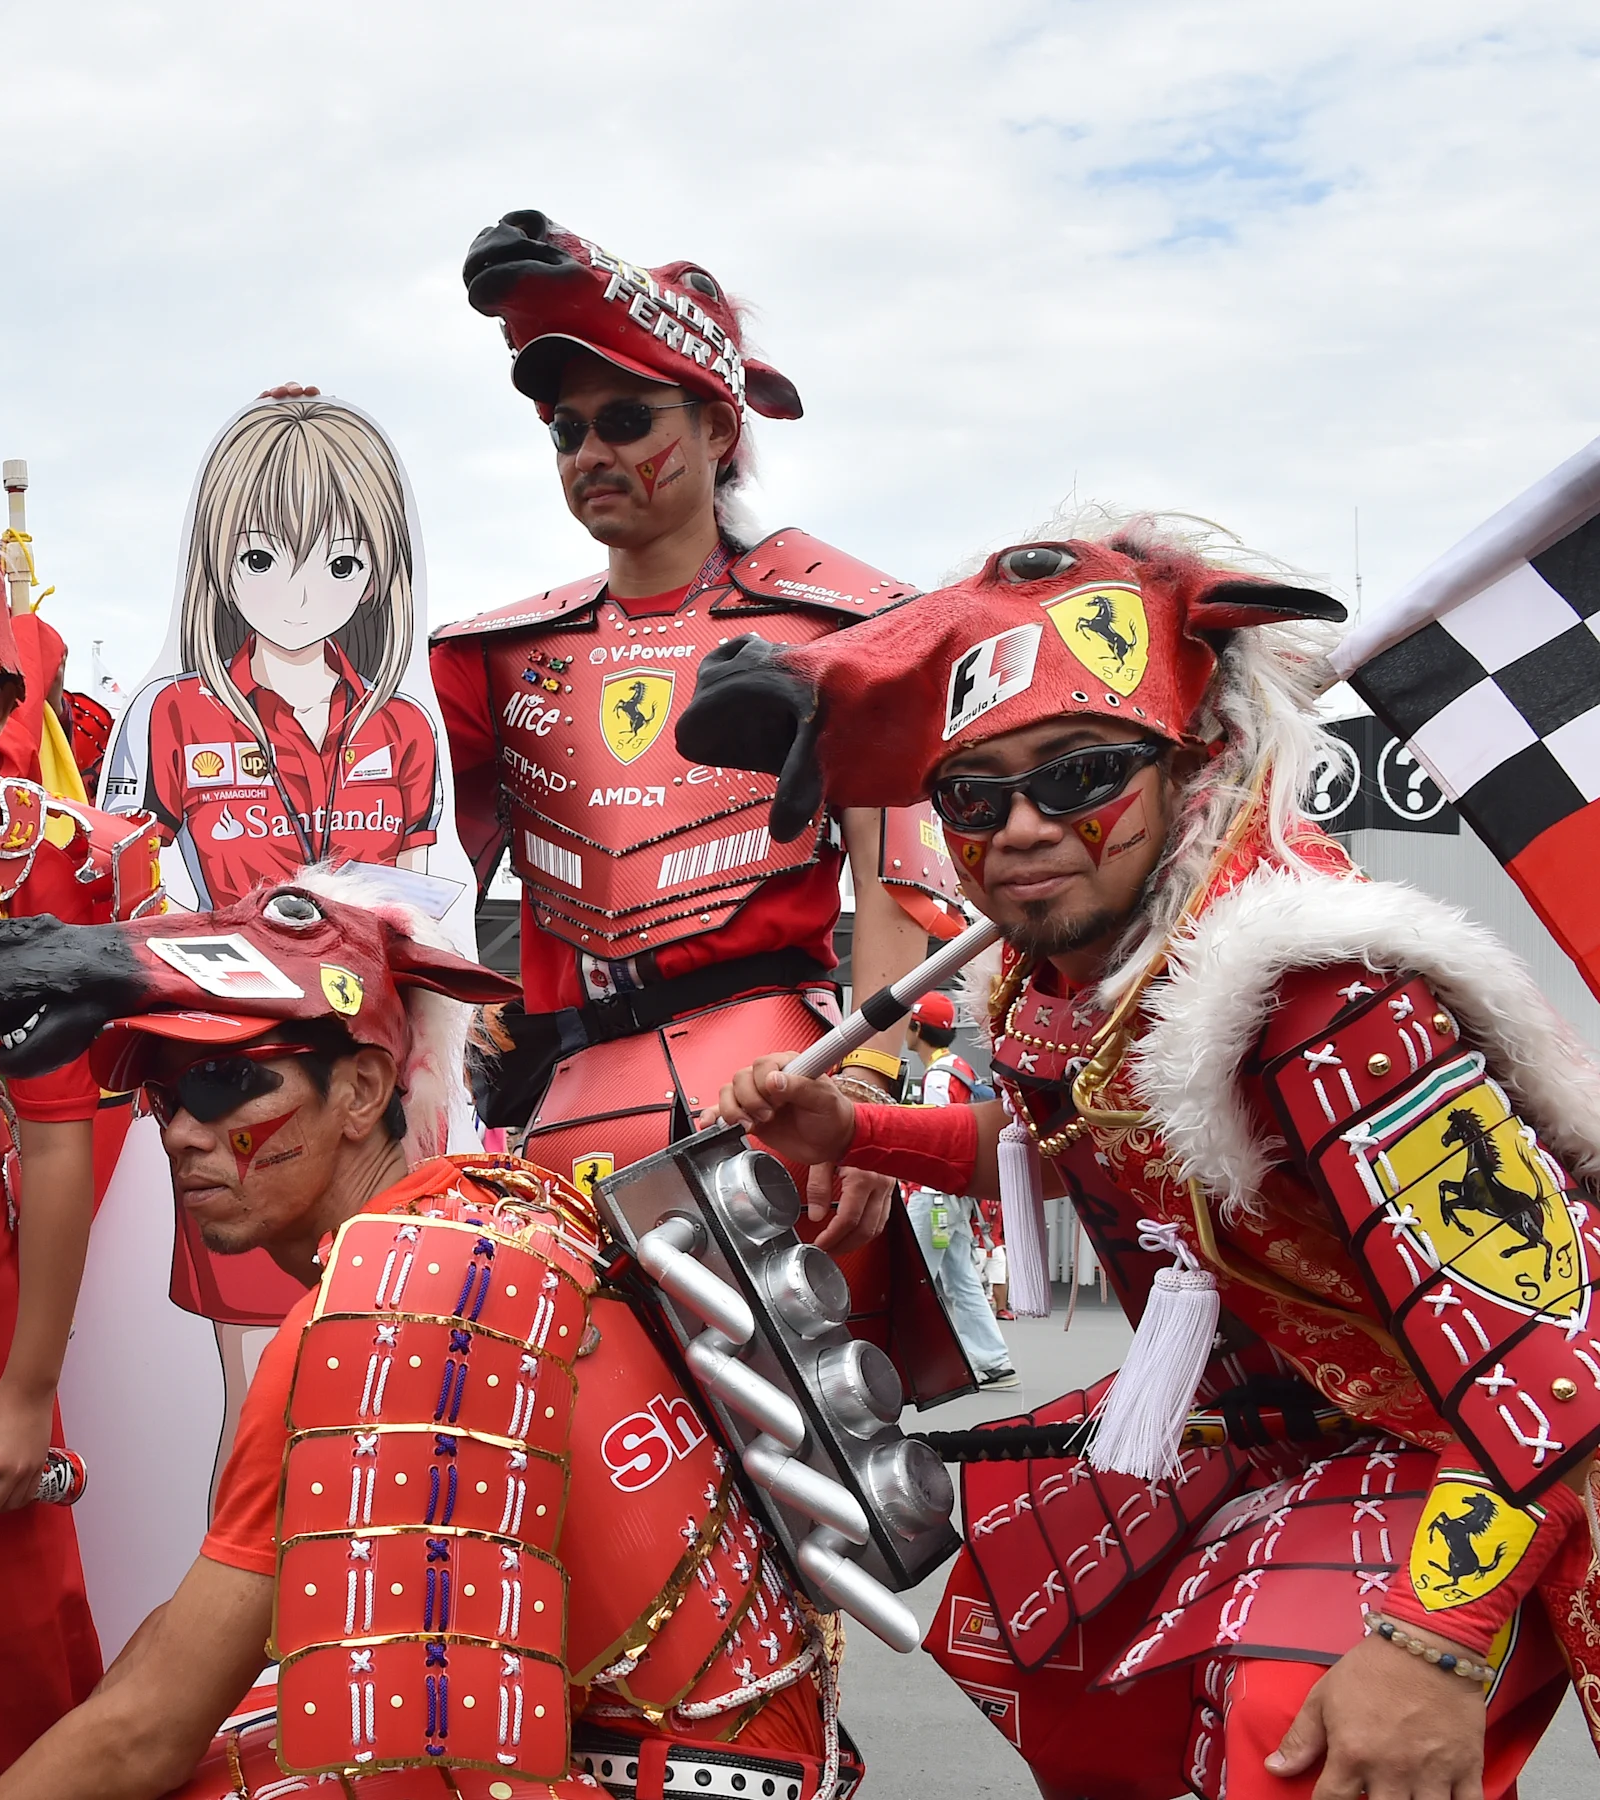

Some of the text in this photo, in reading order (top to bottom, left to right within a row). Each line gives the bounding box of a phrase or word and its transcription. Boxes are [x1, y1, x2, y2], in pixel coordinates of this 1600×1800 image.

[774, 578, 853, 602] MUBADALA
[780, 588, 837, 604] ABU DHABI
[474, 608, 556, 629] MUBADALA
[610, 644, 696, 663] V-Power
[1102, 665, 1115, 680] S
[502, 691, 562, 737] Alice
[948, 700, 989, 736] Formula
[501, 745, 567, 793] ETIHAD
[106, 781, 137, 796] ELLI
[202, 789, 267, 802] M. YAMAGUCHI
[588, 787, 643, 807] AMD
[246, 799, 403, 839] Santander
[161, 942, 201, 973] Formula
[1555, 1240, 1573, 1279] F
[1515, 1271, 1541, 1302] S
[601, 1392, 708, 1492] Sh
[1414, 1573, 1430, 1590] S
[1443, 1588, 1474, 1602] F
